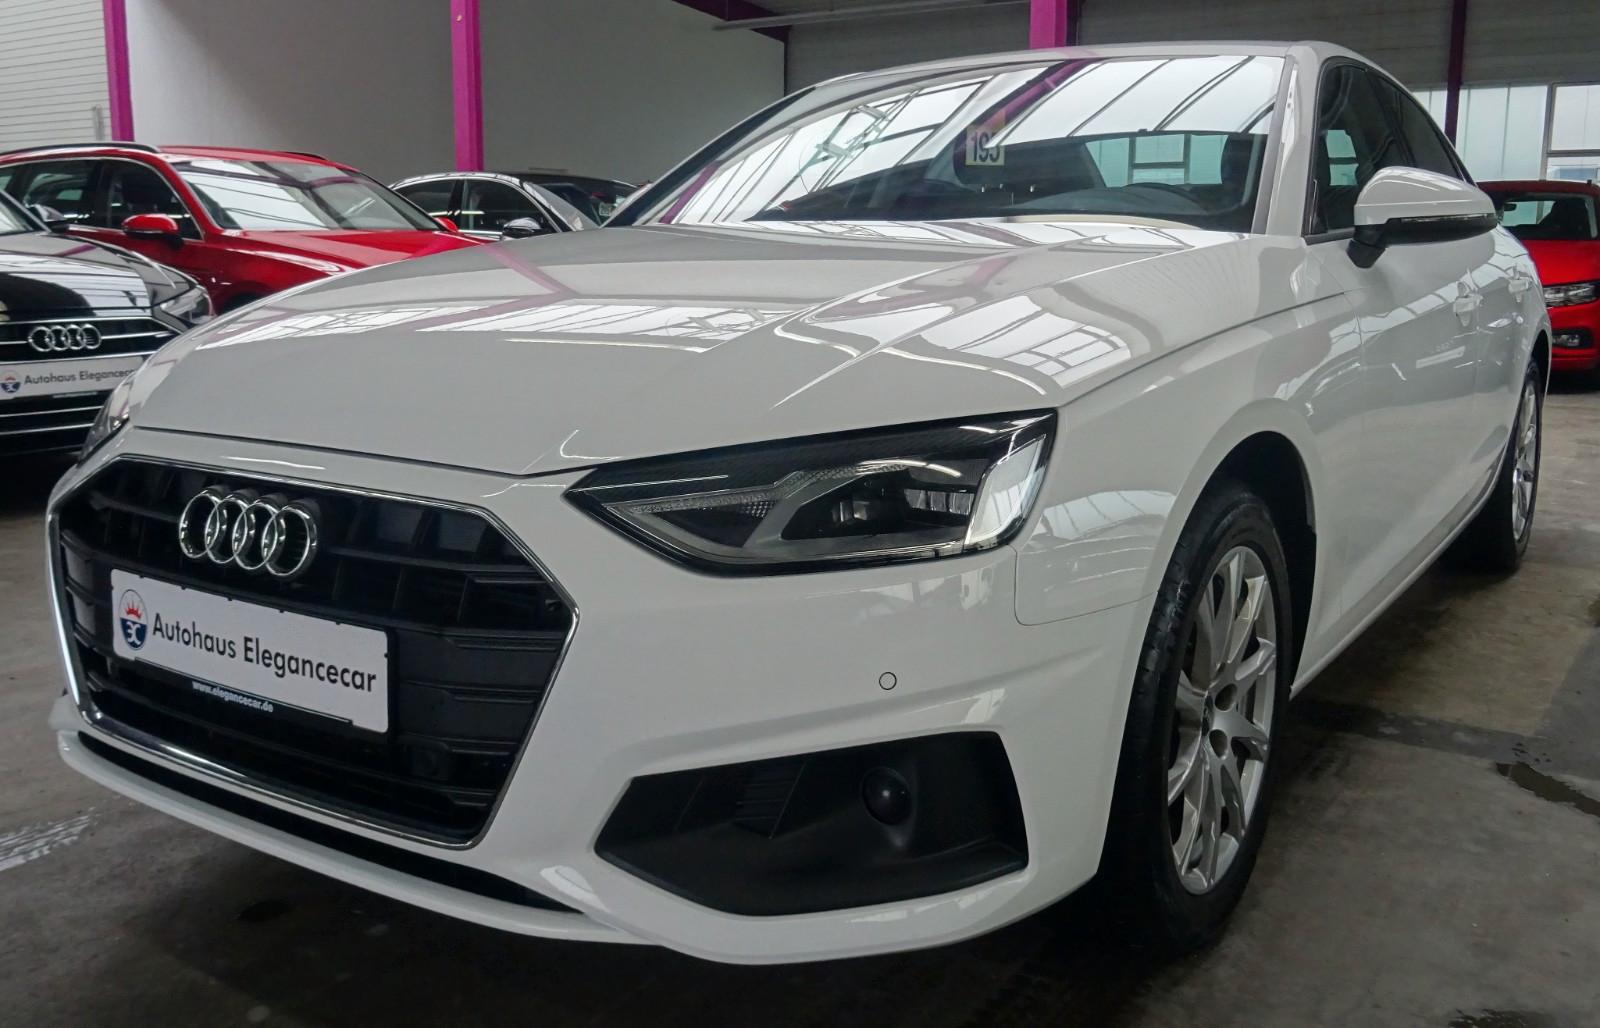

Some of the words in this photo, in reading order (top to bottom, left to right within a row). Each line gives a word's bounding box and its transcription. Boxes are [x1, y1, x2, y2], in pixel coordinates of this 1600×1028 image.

[24, 373, 77, 385] Autohaus
[152, 612, 236, 659] Autohaus
[243, 636, 377, 692] Elegancecar
[191, 680, 274, 713] www.elegancecar.de
